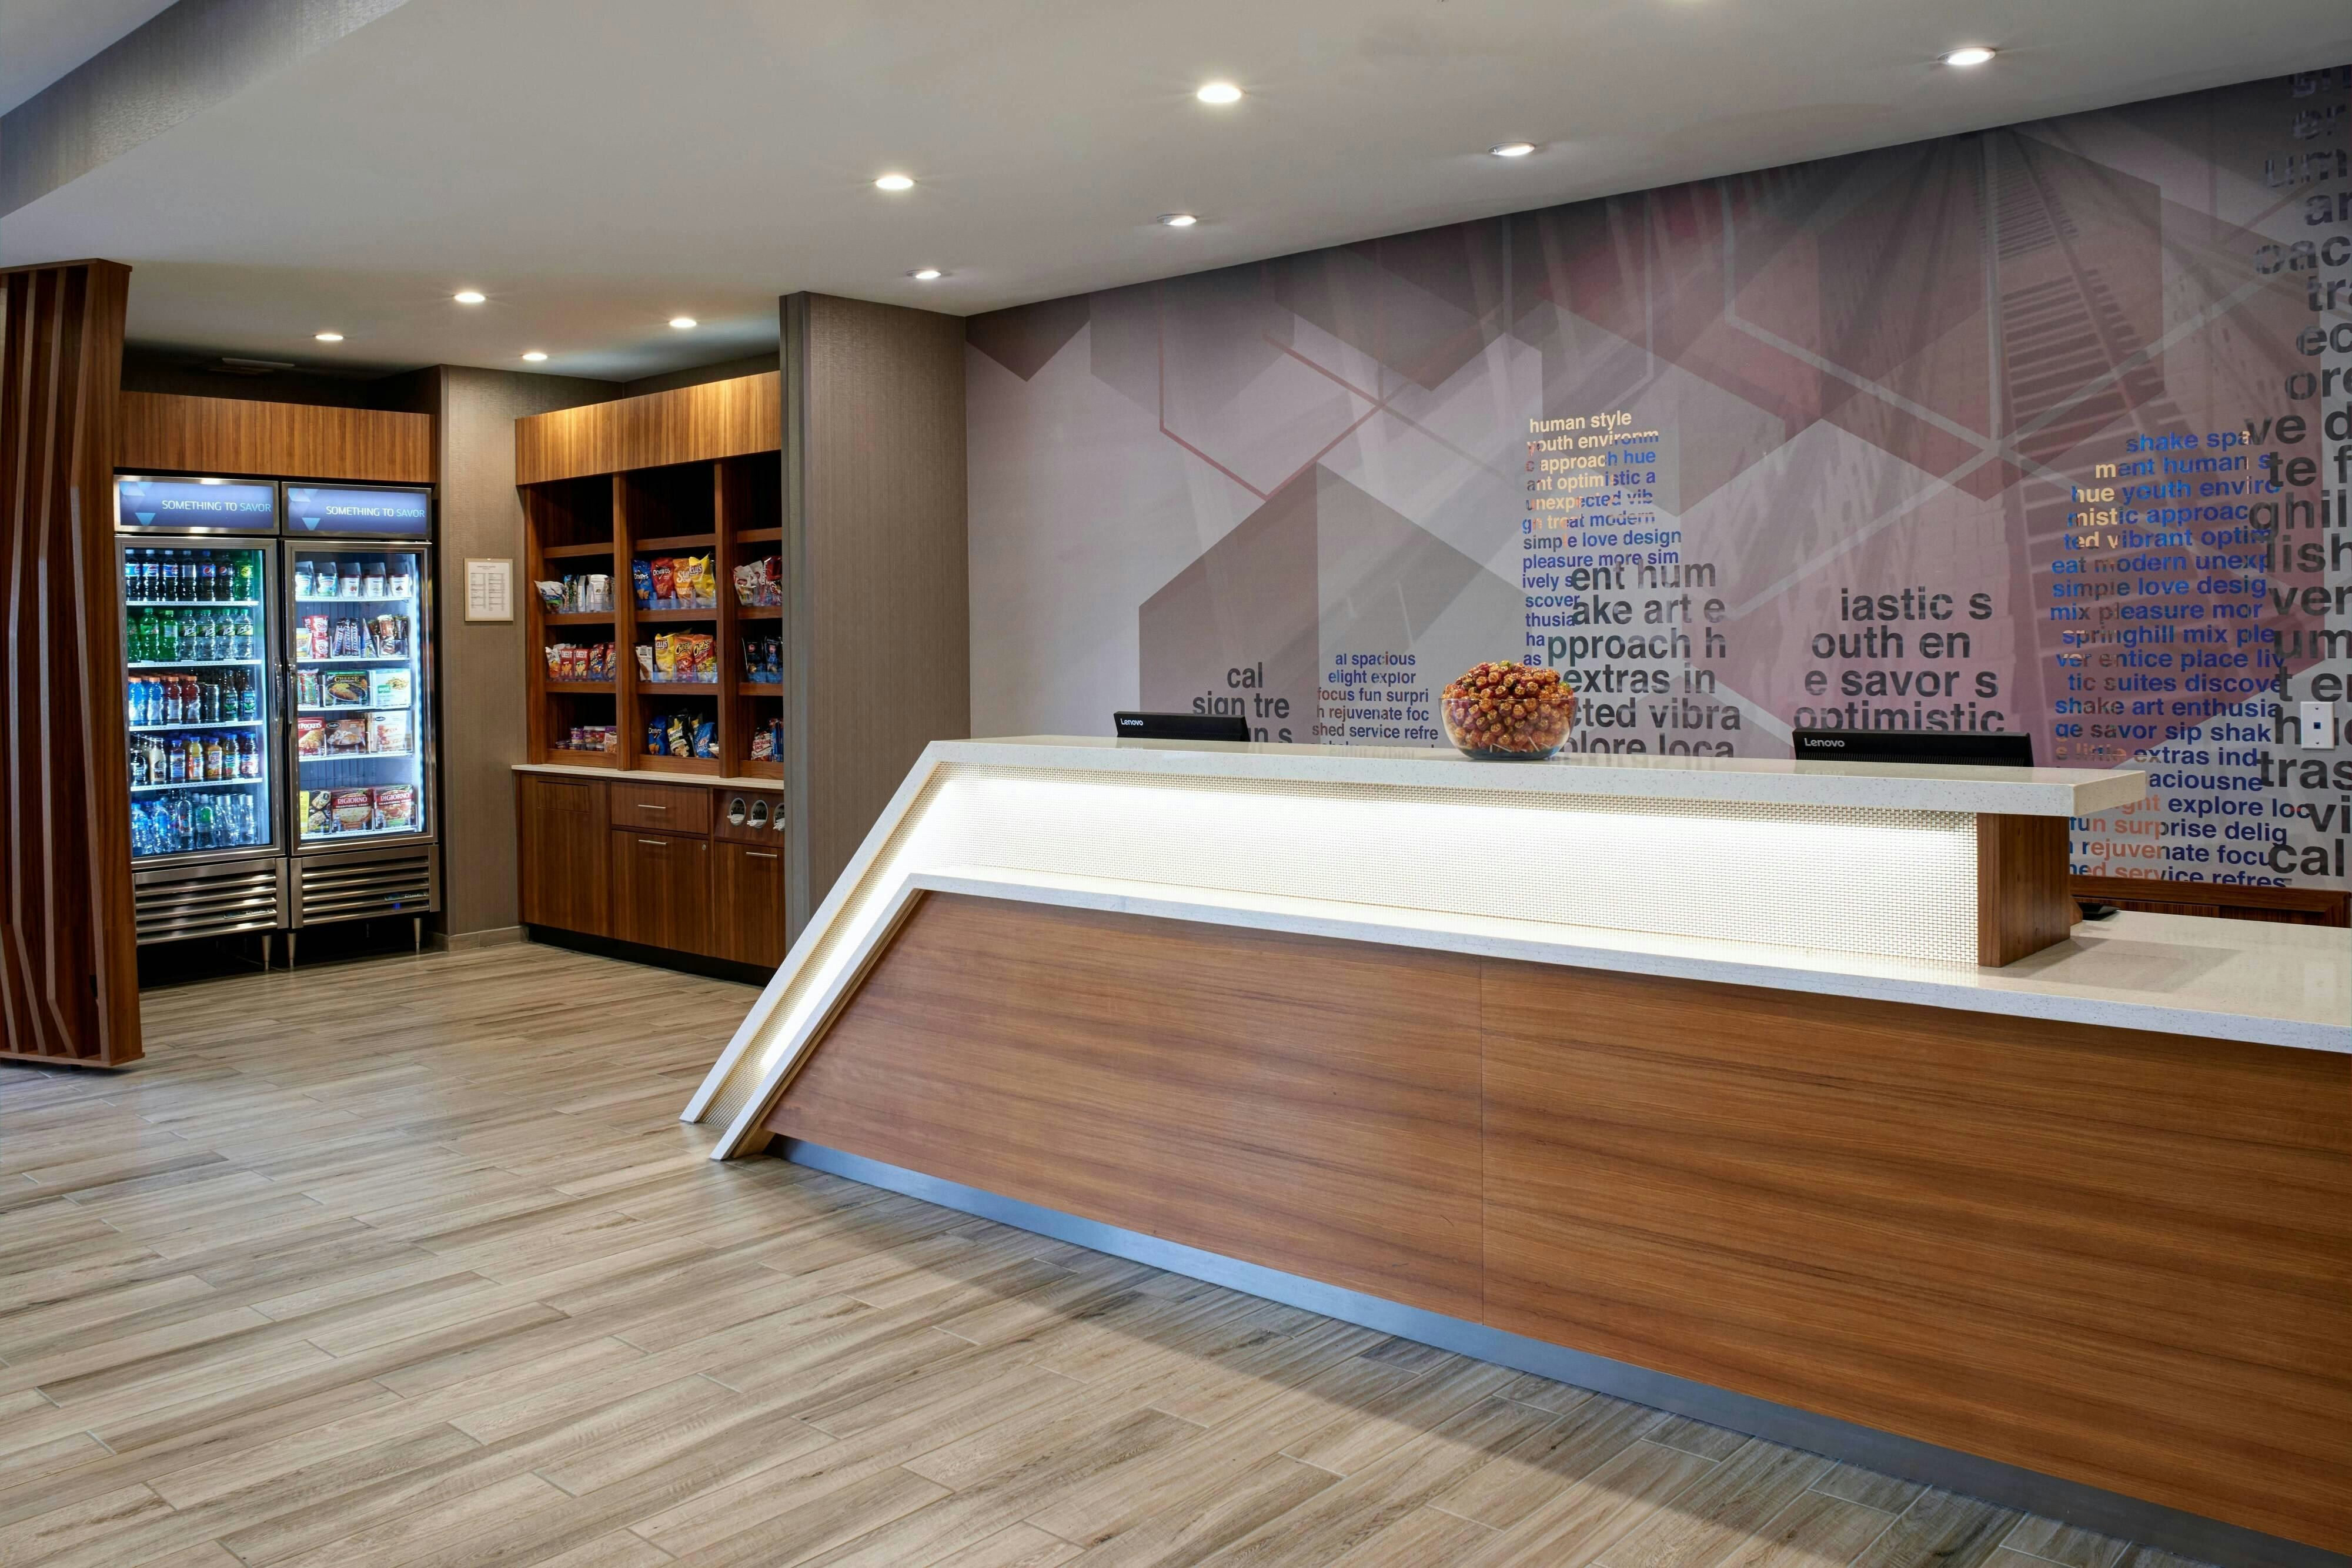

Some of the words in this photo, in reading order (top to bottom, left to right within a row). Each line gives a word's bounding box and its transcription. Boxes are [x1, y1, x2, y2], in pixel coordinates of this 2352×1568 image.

[2307, 276, 2352, 312] tr
[1530, 417, 1585, 433] human
[1591, 410, 1632, 430] style
[2244, 415, 2306, 445] ve
[1527, 435, 1573, 456] youth
[1578, 430, 1659, 447] environm
[2126, 432, 2198, 453] shake
[1540, 452, 1617, 474] approach
[1624, 450, 1656, 464] hue
[2096, 457, 2155, 479] ment
[2164, 454, 2248, 474] human
[2266, 452, 2316, 487] te
[1527, 476, 1552, 492] ant
[1557, 470, 1640, 493] optimistic
[1646, 471, 1656, 483] a
[2072, 485, 2114, 503] hue
[2122, 480, 2191, 505] youth
[162, 500, 222, 511] SOMETHING
[225, 502, 237, 511] TO
[239, 503, 272, 513] SAVOR
[326, 506, 380, 517] SOMETHING
[383, 507, 395, 517] TO
[396, 509, 425, 518] SAVOR
[1526, 490, 1621, 513] unexpected
[1627, 489, 1652, 505] vib
[1547, 514, 1584, 529] treat
[1589, 511, 1655, 527] modern
[2147, 503, 2248, 526] approac
[2249, 489, 2347, 541] ghil
[1524, 534, 1577, 552] simple
[1582, 531, 1618, 547] love
[1623, 529, 1682, 547] design
[2064, 531, 2099, 551] ted
[2107, 530, 2193, 549] vibrant
[1523, 554, 1593, 573] pleasure
[1599, 553, 1642, 567] more
[1648, 549, 1679, 564] sim
[2052, 557, 2087, 574] eat
[2094, 554, 2186, 572] modern
[1522, 573, 1559, 591] ively
[1571, 561, 1625, 591] ent
[1638, 558, 1716, 589] hum
[2052, 579, 2130, 601] simple
[2139, 577, 2189, 596] love
[2197, 575, 2266, 598] desig
[1525, 595, 1580, 607] scover
[1572, 594, 1632, 624] ake
[1644, 594, 1692, 624] art
[1704, 597, 1725, 623] e
[1841, 586, 1953, 621] iastic
[1969, 593, 1992, 620] s
[2050, 602, 2090, 620] mix
[2099, 602, 2204, 624] pleasure
[2213, 603, 2263, 619] mor
[1526, 632, 1545, 646] ha
[1548, 627, 1690, 666] pproach
[1706, 627, 1726, 658] h
[1812, 626, 1903, 658] outh
[1919, 631, 1970, 658] en
[2063, 624, 2174, 648] springhill
[2184, 624, 2227, 643] mix
[2237, 624, 2274, 647] ple
[1336, 654, 1347, 665] al
[1352, 651, 1416, 668] spacious
[1524, 654, 1541, 666] as
[2056, 653, 2092, 668] ver
[2099, 650, 2172, 668] entice
[2181, 650, 2248, 672] place
[2257, 649, 2284, 668] liv
[1227, 662, 1263, 688] cal
[1328, 670, 1367, 687] elight
[1371, 672, 1416, 687] explor
[1563, 664, 1671, 693] extras
[1685, 662, 1715, 694] in
[1805, 669, 1827, 696] e
[1841, 669, 1959, 697] savor
[1975, 670, 1999, 698] s
[2069, 673, 2096, 691] tic
[2104, 673, 2176, 691] suites
[2185, 674, 2282, 693] discove
[1192, 690, 1245, 715] sign
[1254, 693, 1289, 718] tre
[1317, 687, 1355, 701] focus
[1359, 687, 1381, 701] fun
[1387, 688, 1428, 706] surpri
[2056, 697, 2124, 714] shake
[2132, 698, 2164, 716] art
[2172, 698, 2282, 717] enthusia
[1317, 705, 1324, 718] h
[1329, 706, 1402, 722] rejuvenate
[1406, 707, 1429, 721] foc
[1649, 698, 1740, 730] vibra
[1794, 700, 2004, 733] optimistic
[1312, 723, 1344, 736] shed
[1349, 724, 1399, 738] service
[1405, 726, 1438, 740] refre
[1805, 737, 1845, 747] Lenovo
[2056, 722, 2083, 742] ge
[2091, 723, 2157, 740] savor
[2166, 723, 2201, 744] sip
[2211, 723, 2271, 742] shak
[2134, 747, 2210, 764] extras
[2219, 747, 2257, 767] ind
[2168, 795, 2263, 818] explore
[2273, 798, 2310, 818] loc
[2306, 795, 2350, 833] vi
[2070, 816, 2106, 832] fun
[2114, 818, 2217, 840] surprise
[2225, 821, 2287, 845] delig
[2082, 838, 2209, 862] rejuvenate
[2269, 838, 2344, 877] cal
[2114, 865, 2204, 881] service
